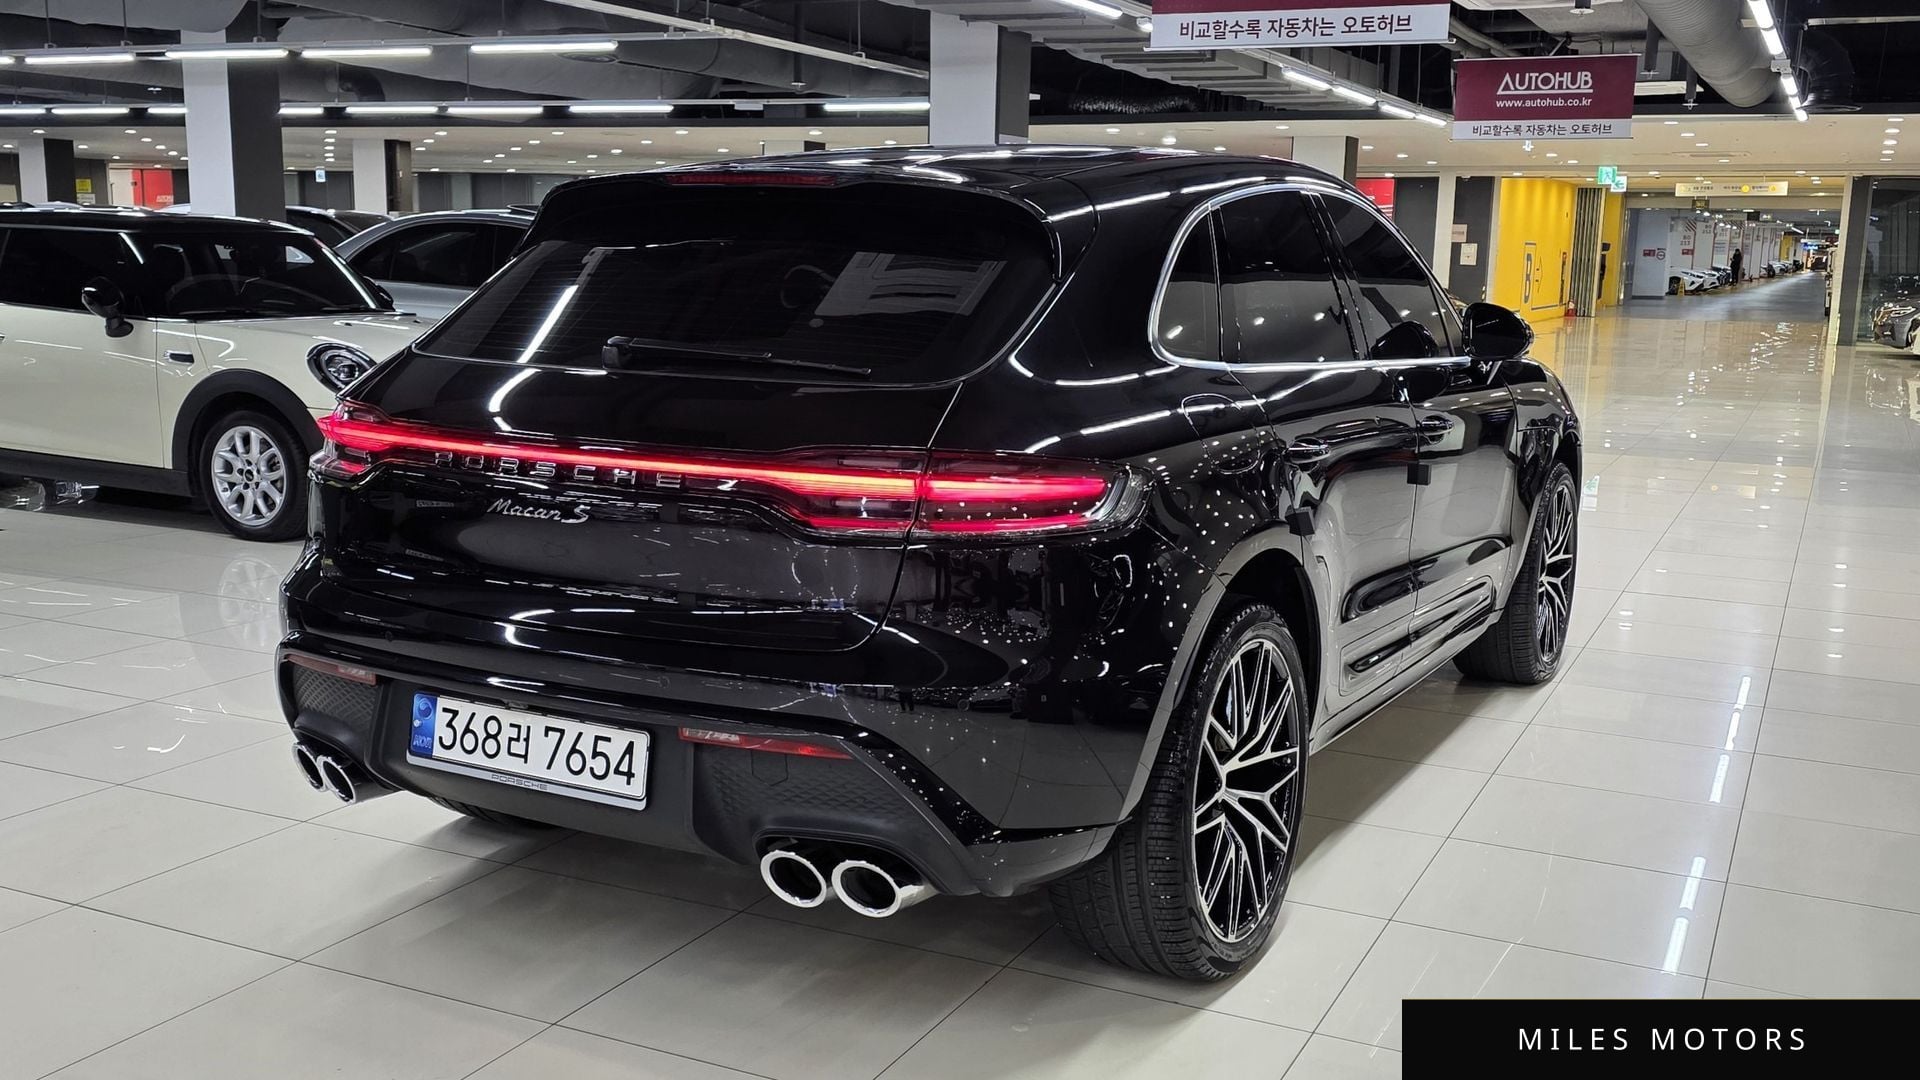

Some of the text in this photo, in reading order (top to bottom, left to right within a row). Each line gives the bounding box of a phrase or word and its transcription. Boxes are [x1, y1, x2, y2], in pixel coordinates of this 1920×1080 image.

[1180, 14, 1412, 40] 비교할수록 자동차는 오토허브
[1497, 71, 1593, 94] AUTOHUB
[1496, 97, 1592, 108] www.autohub.co.kr
[1473, 124, 1612, 137] 비교할수록 자동차는 오토허브
[435, 452, 682, 489] PORSCHE
[487, 498, 591, 523] Macan S
[438, 707, 636, 786] 368러 7654
[491, 773, 548, 791] PORSCHE
